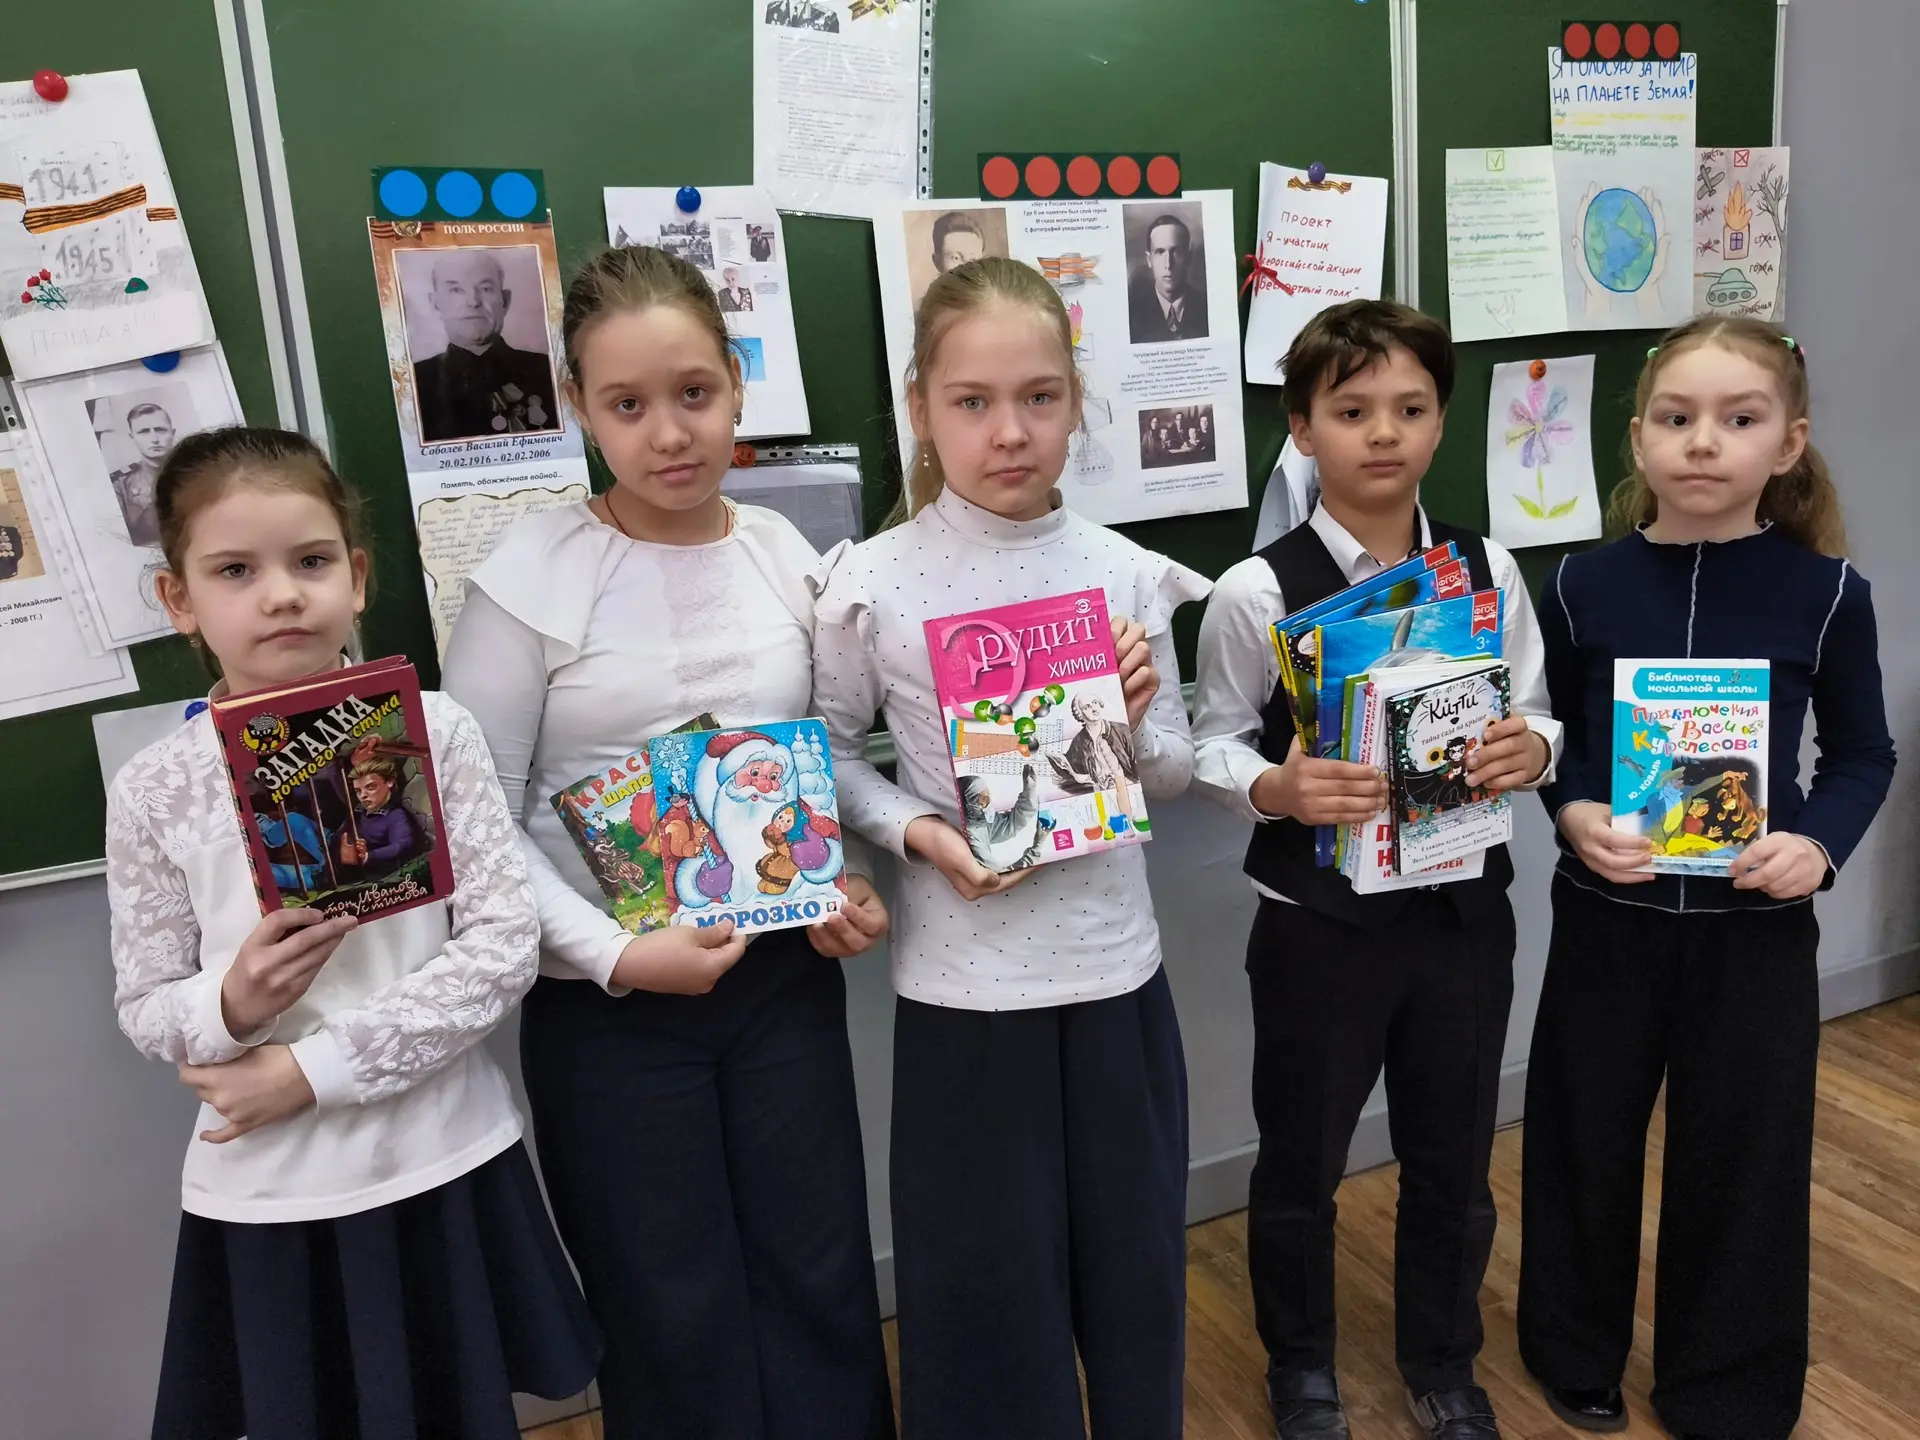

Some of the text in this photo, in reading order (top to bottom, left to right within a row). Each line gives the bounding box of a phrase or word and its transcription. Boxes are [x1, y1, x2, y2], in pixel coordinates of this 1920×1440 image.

[1552, 47, 1563, 79] Я
[1658, 54, 1696, 78] МИР
[1553, 87, 1570, 104] НА
[1577, 84, 1640, 102] ПЛАНЕТЕ
[28, 163, 97, 203] 1941
[443, 223, 525, 235] ПОЛК РОССИИ
[1281, 211, 1332, 228] Проект
[1266, 230, 1274, 243] Я
[1283, 237, 1330, 251] участник
[55, 237, 113, 278] 1945
[1261, 257, 1362, 277] сероссийской акции
[420, 434, 563, 457] Соболев Василий Ефимович
[439, 455, 491, 469] 20.02.1916
[500, 448, 551, 463] 02.02.2006
[440, 480, 475, 490] Память,
[477, 475, 529, 487] обожжённая
[1438, 572, 1460, 586] ФГОС
[13, 596, 62, 609] Михайлович
[1473, 604, 1496, 615] ФГОС
[10, 615, 28, 625] 2008
[1476, 636, 1491, 651] 3+
[1047, 653, 1107, 679] ХИМИЯ
[1648, 672, 1720, 683] Библиотека
[1648, 683, 1757, 694] начальной школы
[1632, 703, 1759, 726] Приключения
[1440, 727, 1455, 738] сада
[1681, 720, 1736, 740] Васи
[254, 693, 375, 790] ЗАГАДКА
[271, 694, 400, 804] ночного стука
[1632, 729, 1759, 756] Куролесова
[1420, 857, 1464, 873] УЗЕЙ
